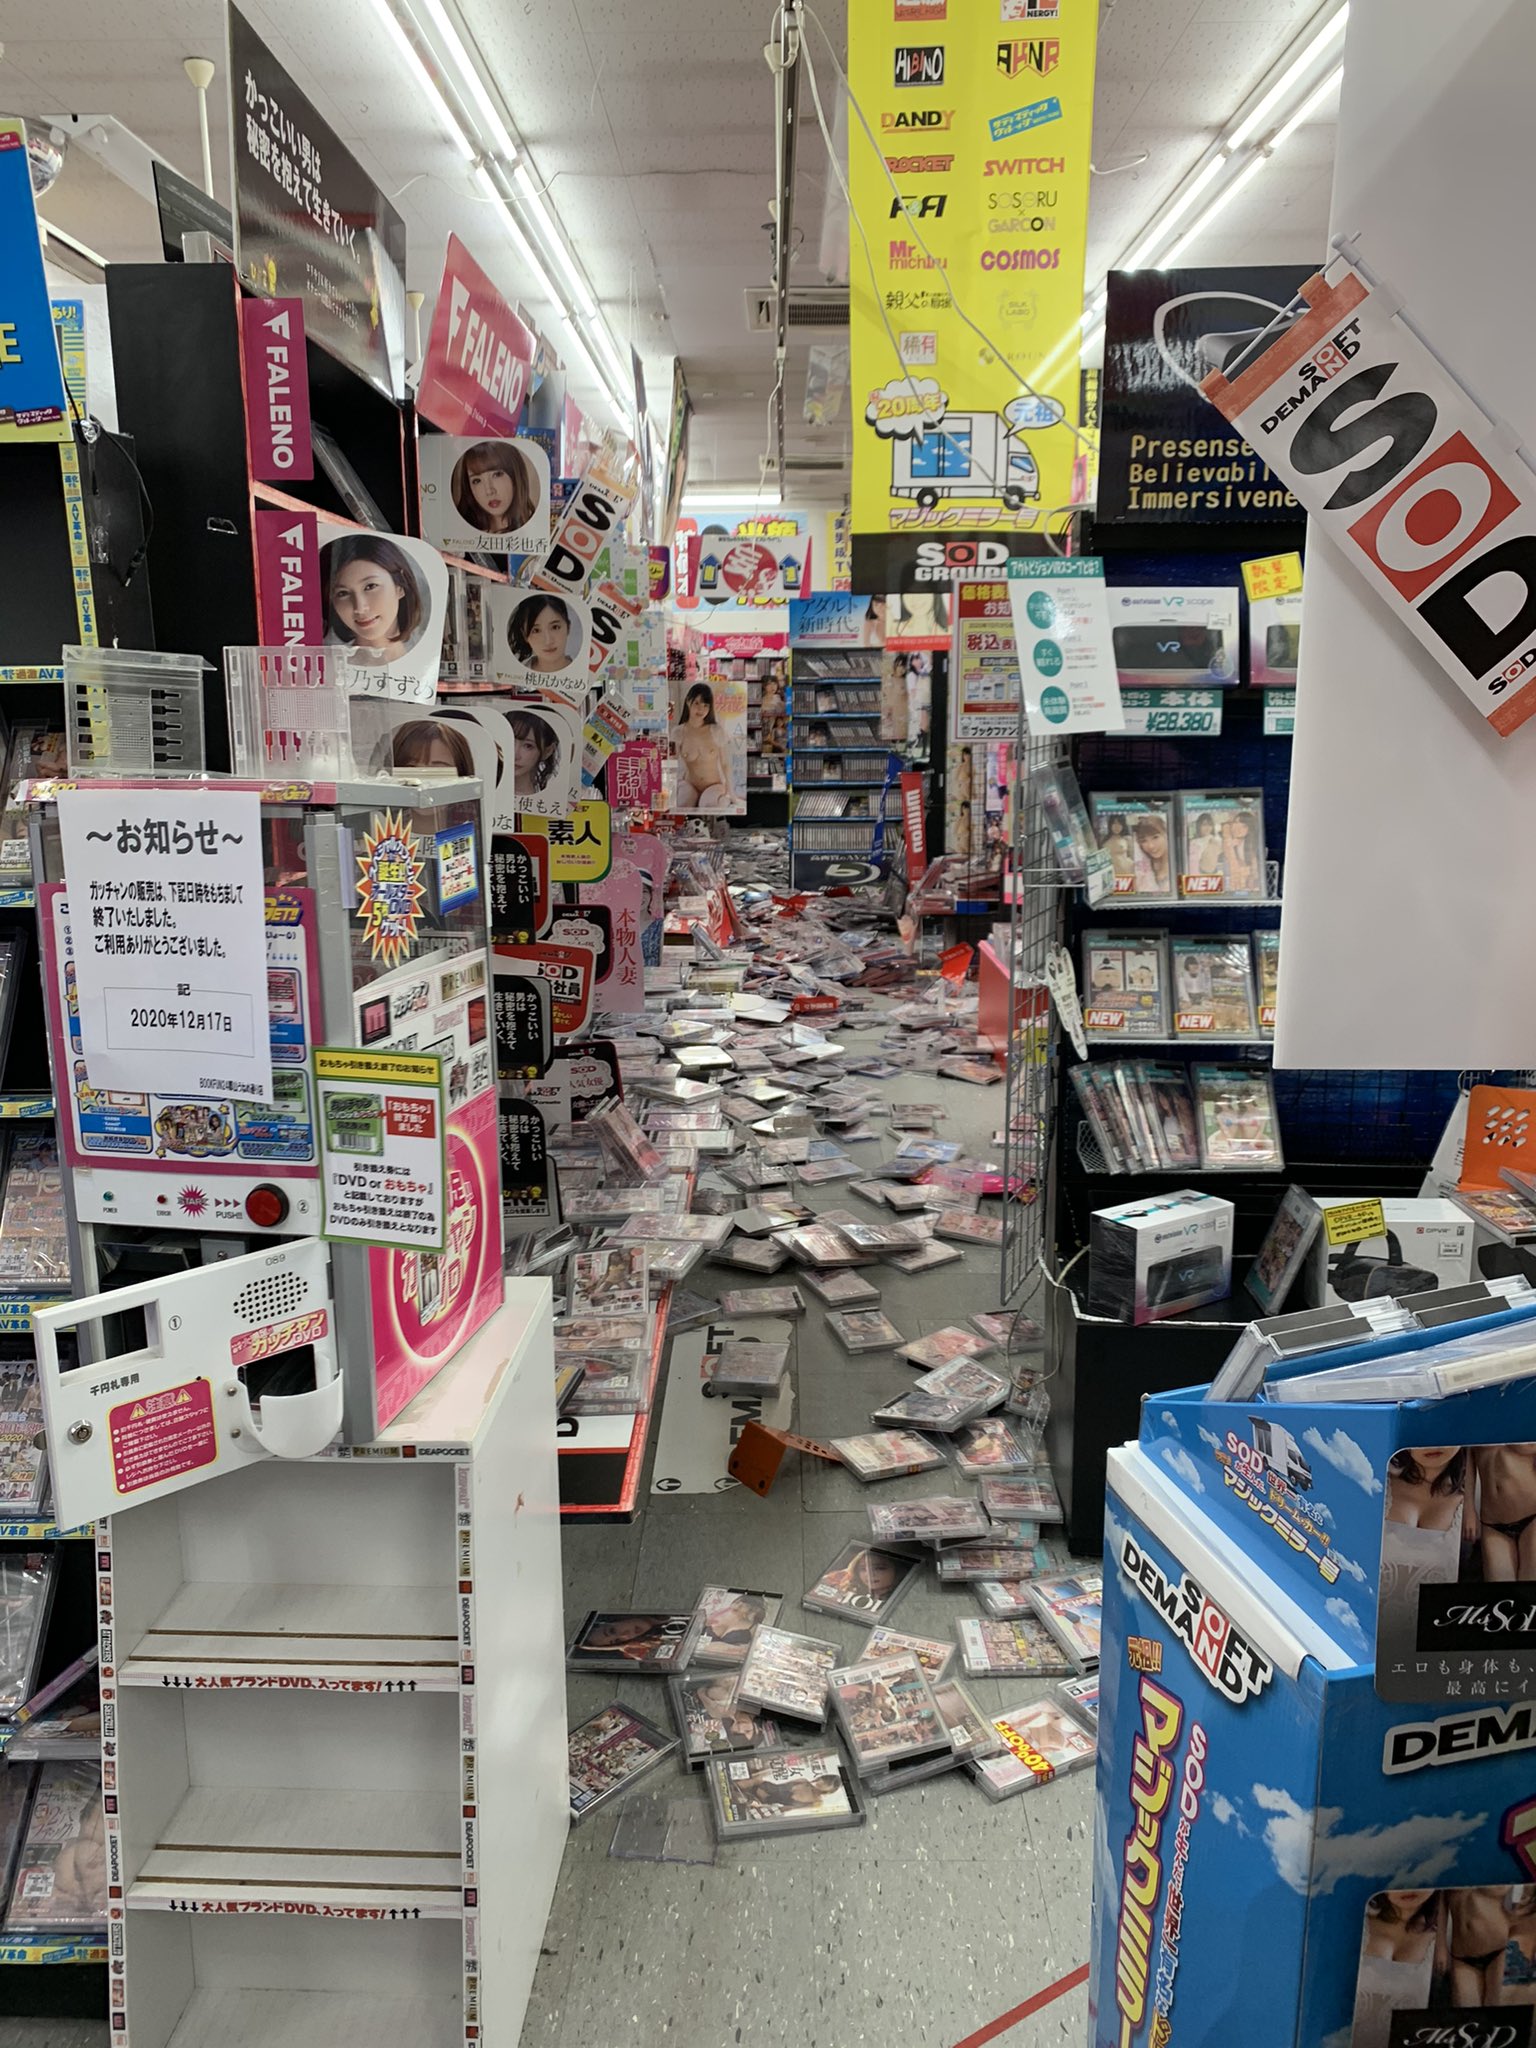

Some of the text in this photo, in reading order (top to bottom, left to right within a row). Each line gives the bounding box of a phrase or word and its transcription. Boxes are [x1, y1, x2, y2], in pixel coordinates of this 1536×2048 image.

[895, 48, 943, 81] HIBINO
[245, 68, 322, 183] かっこいい男は
[881, 110, 956, 130] DANDY
[884, 155, 955, 173] ROCKET
[983, 157, 1065, 176] SWITCH
[246, 113, 362, 265] 秘密を抱えて生きていく。
[988, 190, 1058, 210] SOSORU
[889, 240, 917, 258] Mr
[980, 248, 1061, 271] COSMOS
[889, 253, 948, 270] michiru
[460, 310, 524, 417] FALENO
[1260, 340, 1361, 435] DEMAND
[266, 346, 295, 470] FALENO
[1013, 402, 1055, 423] 元祖
[1130, 434, 1255, 460] Presense
[1127, 486, 1299, 510] Immersivene
[71, 503, 83, 541] AV革命
[889, 506, 1041, 530] マジックミラー号
[1290, 362, 1536, 682] SOD
[476, 534, 549, 554] 友田彩也香
[545, 492, 616, 583] SOD
[916, 541, 1010, 567] SOD
[81, 595, 93, 633] AV革命
[1162, 596, 1185, 608] VR
[800, 614, 861, 635] 新時代。
[1156, 640, 1182, 654] VR
[525, 672, 587, 691] 桃尻かなめ
[1159, 691, 1214, 707] 本体
[617, 756, 630, 800] ミチル
[629, 755, 642, 799] ミスター
[514, 796, 563, 816] 使もえ
[547, 819, 602, 846] 素人
[906, 788, 923, 854] million
[505, 853, 517, 875] 男は
[494, 853, 507, 914] 秘密を抱えて
[516, 853, 530, 904] かっこいい
[1186, 876, 1222, 891] NEW
[89, 880, 244, 904] ガッチャンの販売は、下記日時をもちまして
[92, 906, 177, 929] 終了いたしました。
[94, 934, 227, 959] ご利用ありがとうございました。
[616, 908, 638, 986] 本物人妻
[176, 983, 191, 997] 記
[553, 979, 581, 997] 社員
[515, 991, 527, 1012] 男は
[130, 1007, 232, 1033] 2020年12月17日
[494, 992, 507, 1044] 生きていく。
[504, 991, 517, 1050] 秘密を抱えて
[526, 992, 539, 1041] かっこいい
[1088, 1010, 1122, 1026] NEW
[1178, 1014, 1213, 1030] NEW
[319, 1058, 435, 1076] おもちゃ引き換え終了のお知らせ
[570, 1065, 597, 1075] SOD
[397, 1122, 423, 1134] ました
[519, 1114, 531, 1134] 男は
[499, 1114, 511, 1165] 生きていく。
[508, 1114, 521, 1171] 秘密を抱えて
[529, 1115, 543, 1162] かっこいい
[353, 1162, 411, 1177] 引き換え券には
[369, 1179, 382, 1190] or
[343, 1190, 424, 1207] と記載しておりますが
[215, 1210, 243, 1219] PUSH!!
[333, 1202, 436, 1222] おもちゃ引き換えは終了の為
[329, 1214, 439, 1236] DVDのみ引き換えとなります
[1178, 1268, 1196, 1282] VR
[251, 1313, 325, 1358] ガッチャン
[292, 1326, 323, 1345] DVD
[90, 1372, 140, 1397] 千円札専用
[352, 1446, 401, 1458] PREMIUM
[418, 1447, 471, 1457] IDEAPOCKET
[1227, 1430, 1264, 1474] SOD
[1224, 1464, 1342, 1585] マジックミラー号
[461, 1530, 471, 1577] PREMIUM
[461, 1597, 471, 1647] IDEAPOCKET
[1122, 1540, 1244, 1696] DEMAND
[1391, 1658, 1535, 1676] エロも身体も、
[194, 1676, 382, 1693] 大人気ブランドDVD、入ってます!
[994, 1721, 1049, 1773] 40%OFF
[1391, 1708, 1536, 1767] DEM
[464, 1755, 475, 1802] PREMIUM
[1180, 1723, 1208, 1823] SOD
[464, 1821, 475, 1870] IDEAPOCKET
[109, 1834, 120, 1883] IDEAPOCKET
[201, 1901, 386, 1920] 大人気ブランドDVD、入ってます!
[468, 1976, 478, 2021] PREMIUM
